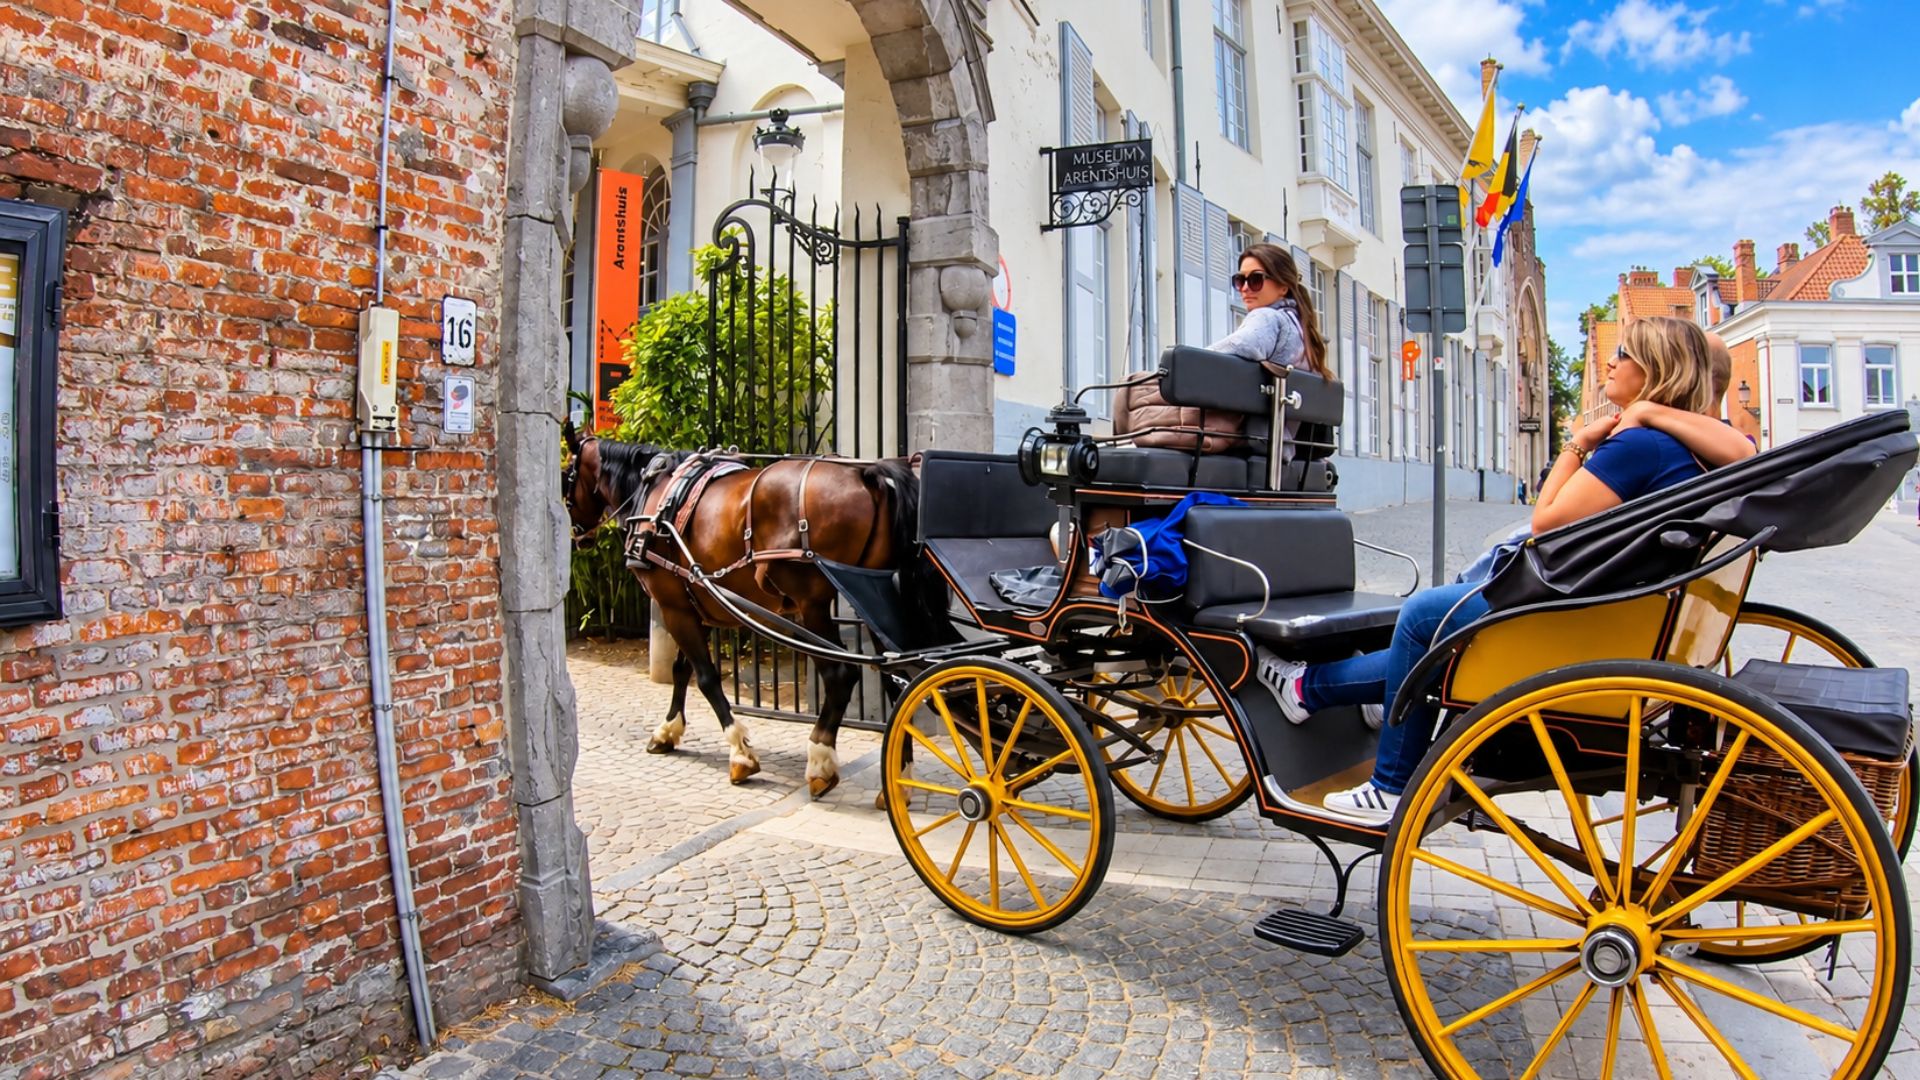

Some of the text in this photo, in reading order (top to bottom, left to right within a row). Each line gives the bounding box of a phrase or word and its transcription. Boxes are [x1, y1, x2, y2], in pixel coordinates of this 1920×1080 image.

[1073, 147, 1137, 165] MUSEUM
[1063, 165, 1149, 185] ARENTSHUIS
[447, 316, 473, 349] 16
